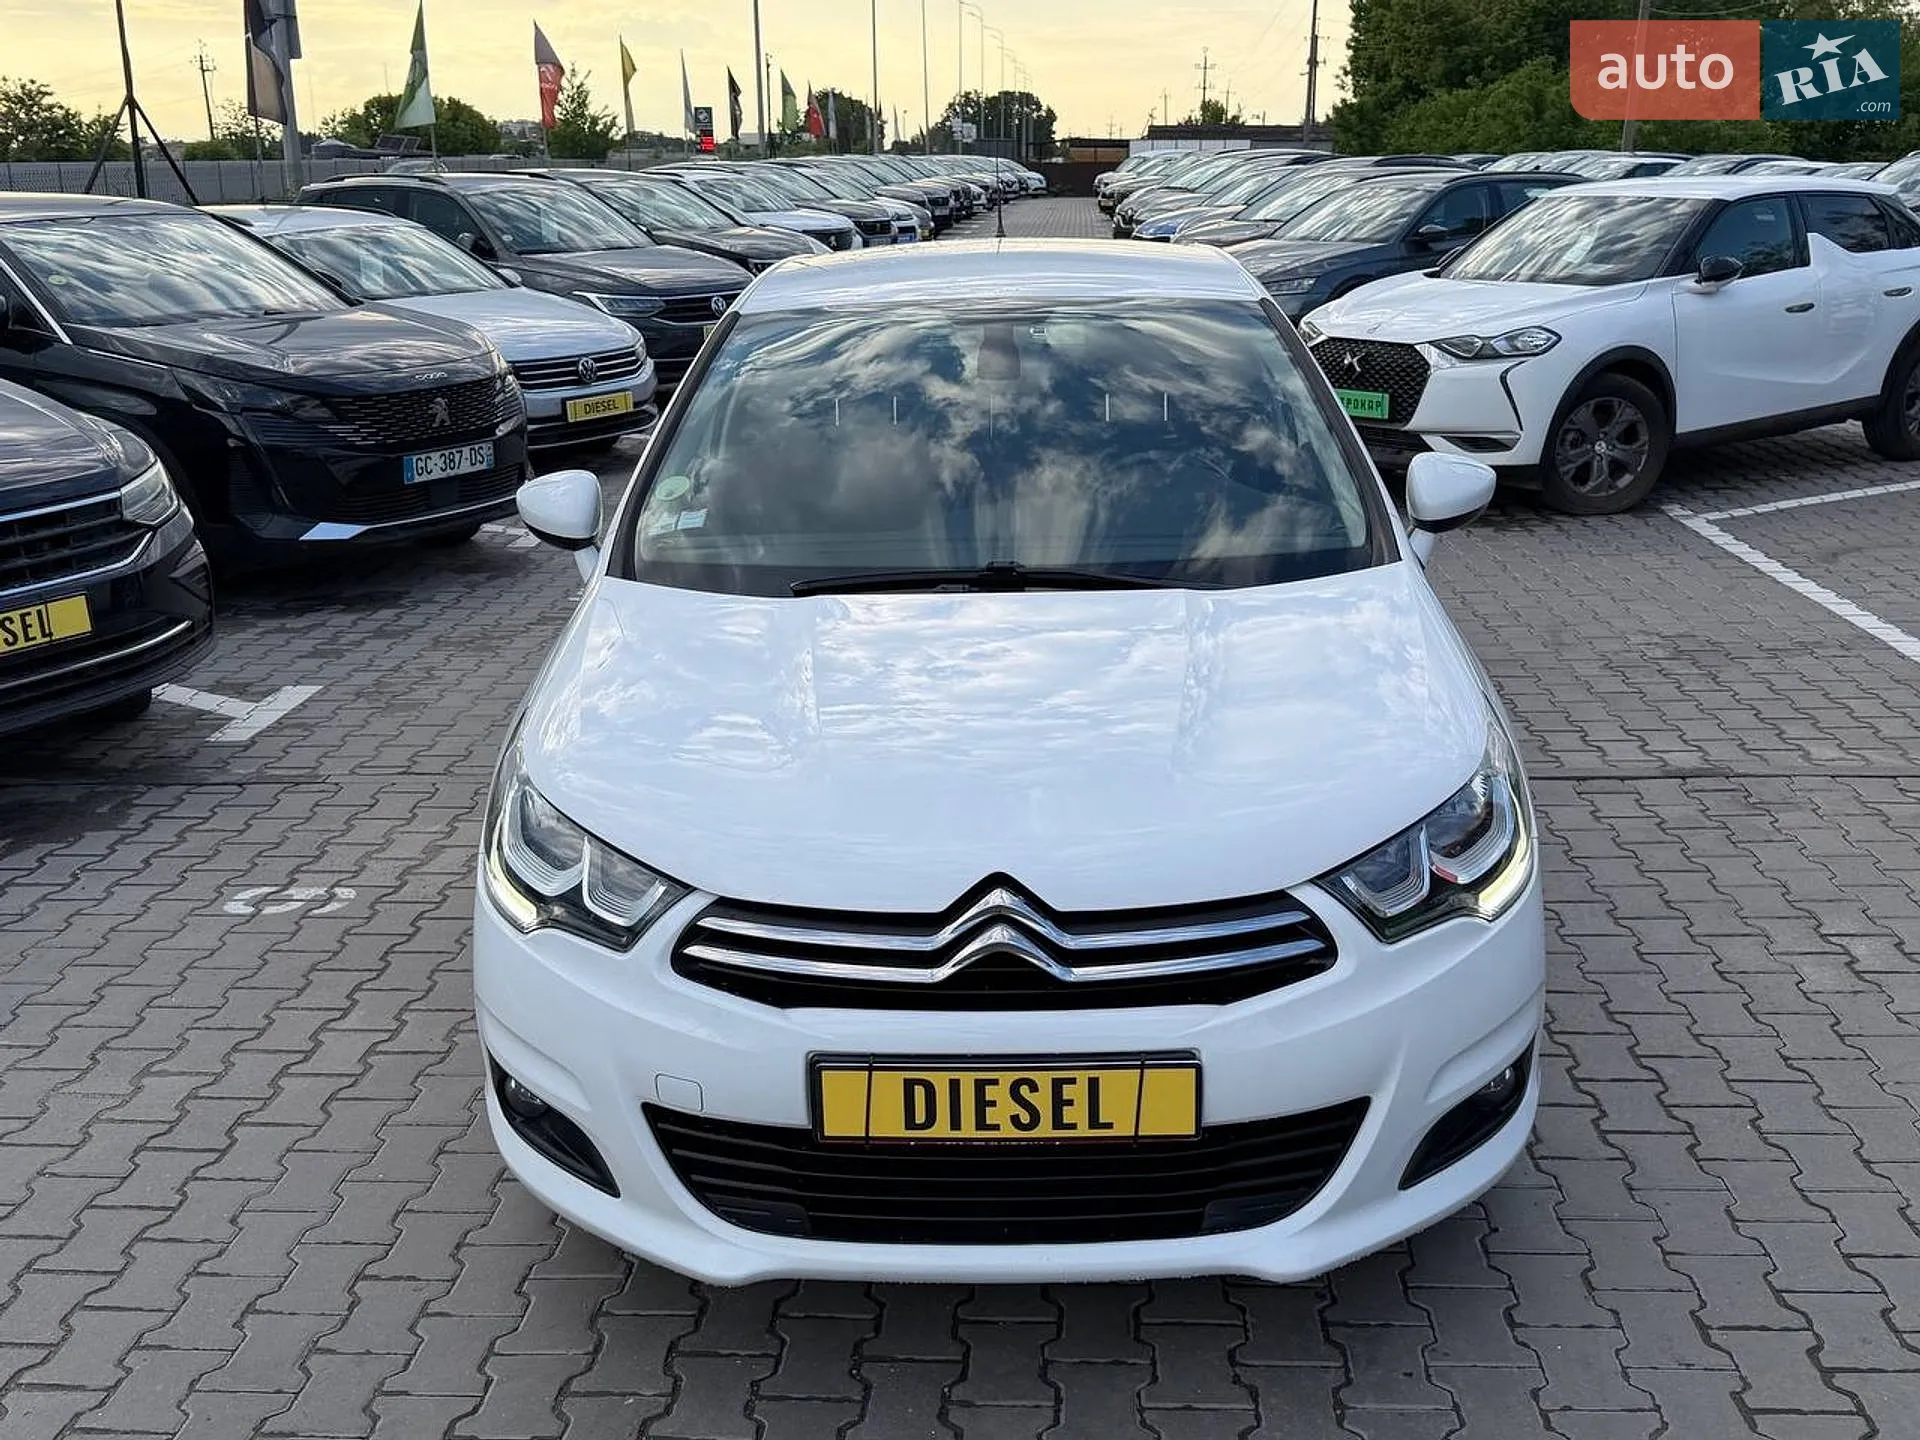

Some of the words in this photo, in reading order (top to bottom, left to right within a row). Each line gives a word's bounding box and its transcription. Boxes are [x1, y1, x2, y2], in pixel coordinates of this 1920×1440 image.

[584, 399, 619, 415] DIESEL
[415, 446, 486, 477] GC-387-DS
[903, 1077, 1114, 1132] DIESEL
